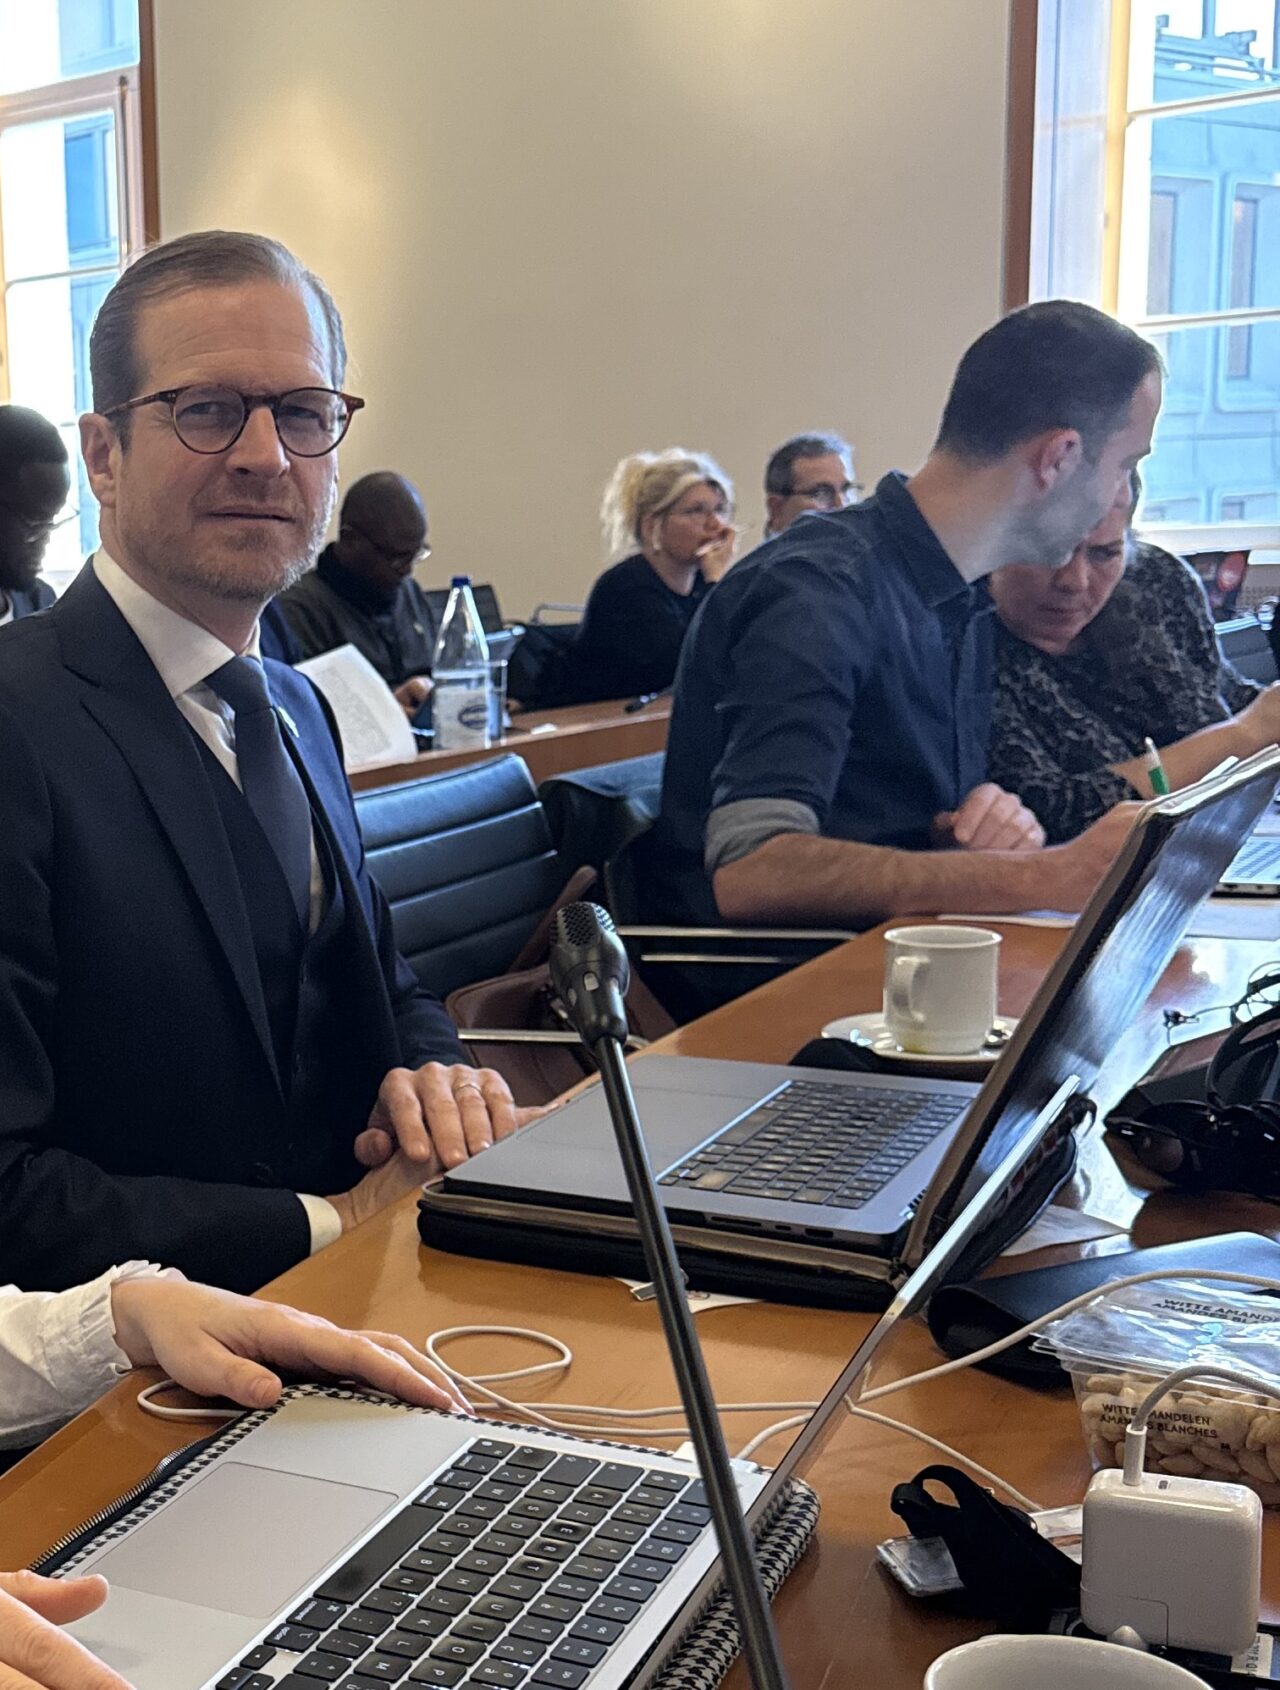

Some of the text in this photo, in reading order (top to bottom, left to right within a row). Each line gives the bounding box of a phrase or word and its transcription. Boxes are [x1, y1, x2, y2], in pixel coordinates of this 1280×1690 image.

[1164, 1299, 1213, 1311] WITTE
[1102, 1403, 1210, 1425] WITTE MANDELEN
[1100, 1414, 1218, 1438] AMANS BLANCHES
